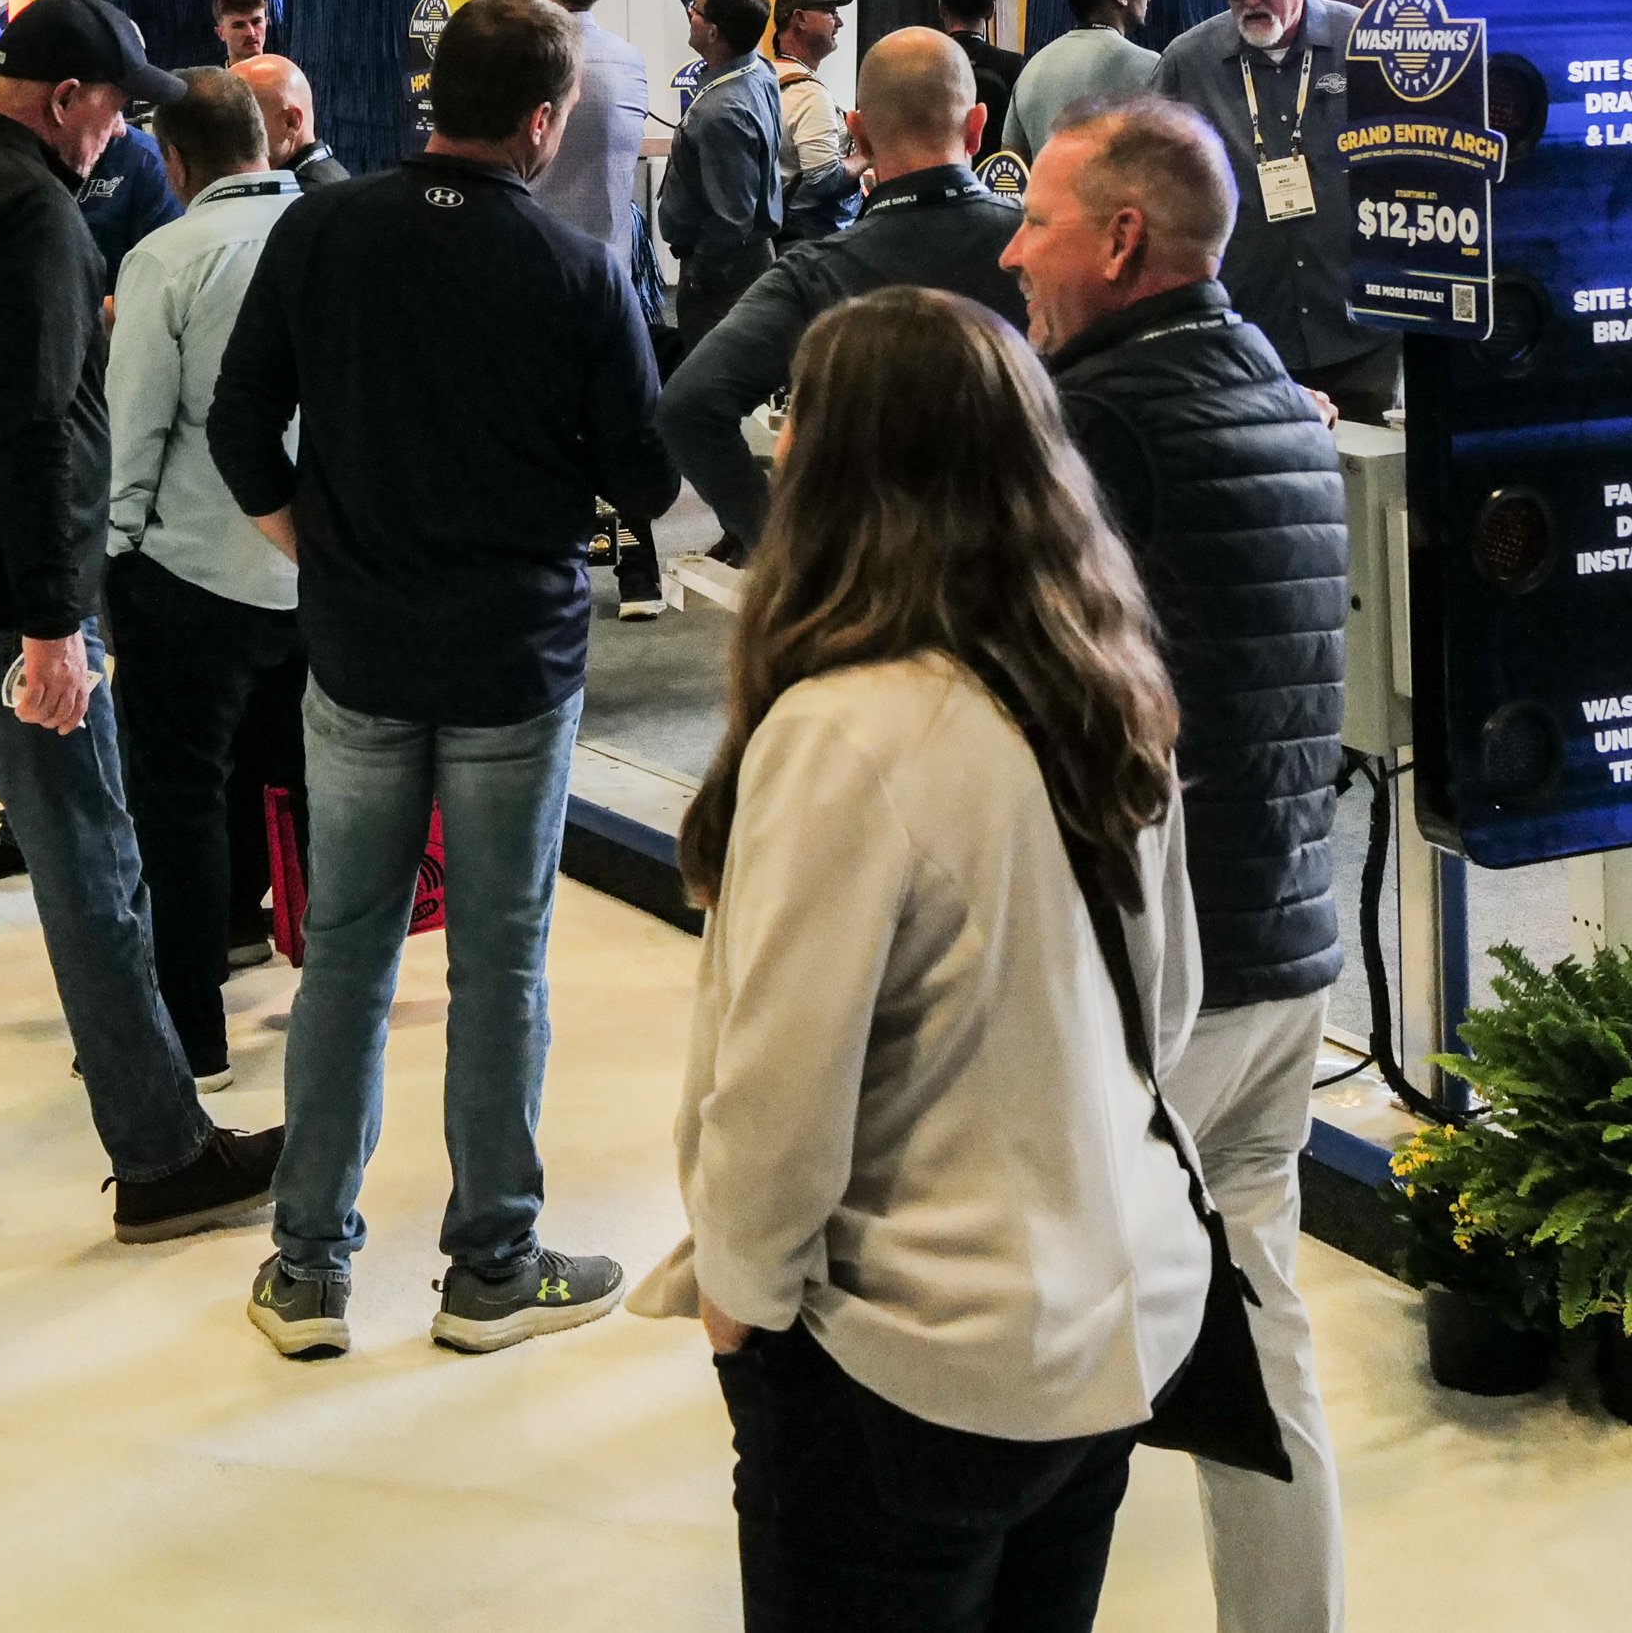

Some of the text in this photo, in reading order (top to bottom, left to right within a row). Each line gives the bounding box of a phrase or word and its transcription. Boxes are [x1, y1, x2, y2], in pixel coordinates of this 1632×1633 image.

[413, 19, 432, 32] WASH
[1354, 28, 1403, 51] WASH
[674, 76, 698, 86] WAS
[1393, 71, 1430, 94] CITY
[1568, 61, 1620, 84] SITE
[1336, 125, 1392, 153] GRAND
[1394, 123, 1449, 147] ENTRY
[1451, 130, 1500, 163] ARCH
[1585, 127, 1603, 148] &
[990, 160, 1021, 182] MOTOR
[892, 194, 919, 206] SIMPLE
[1357, 197, 1479, 247] $12,500
[1365, 284, 1444, 304] SEE MORE DETAILS!
[1573, 288, 1627, 312] SITE
